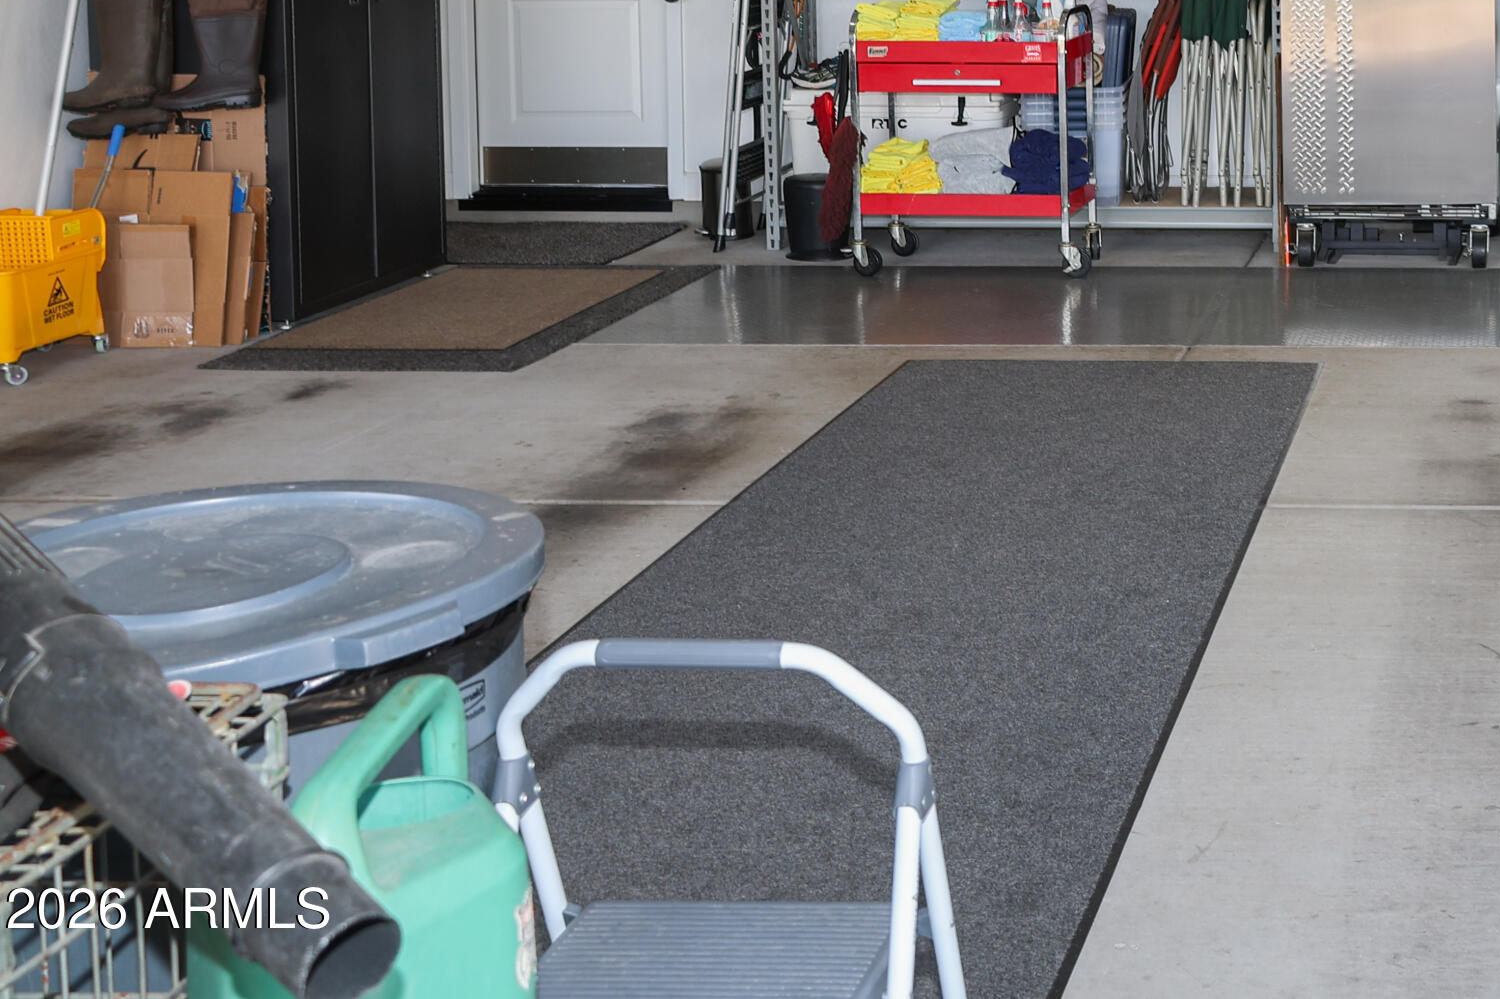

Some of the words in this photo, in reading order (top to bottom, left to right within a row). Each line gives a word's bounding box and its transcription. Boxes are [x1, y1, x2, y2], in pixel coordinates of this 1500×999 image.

[872, 119, 907, 129] RTC
[43, 301, 74, 316] CAUTION
[44, 315, 55, 324] WET
[56, 308, 75, 320] FLOOR
